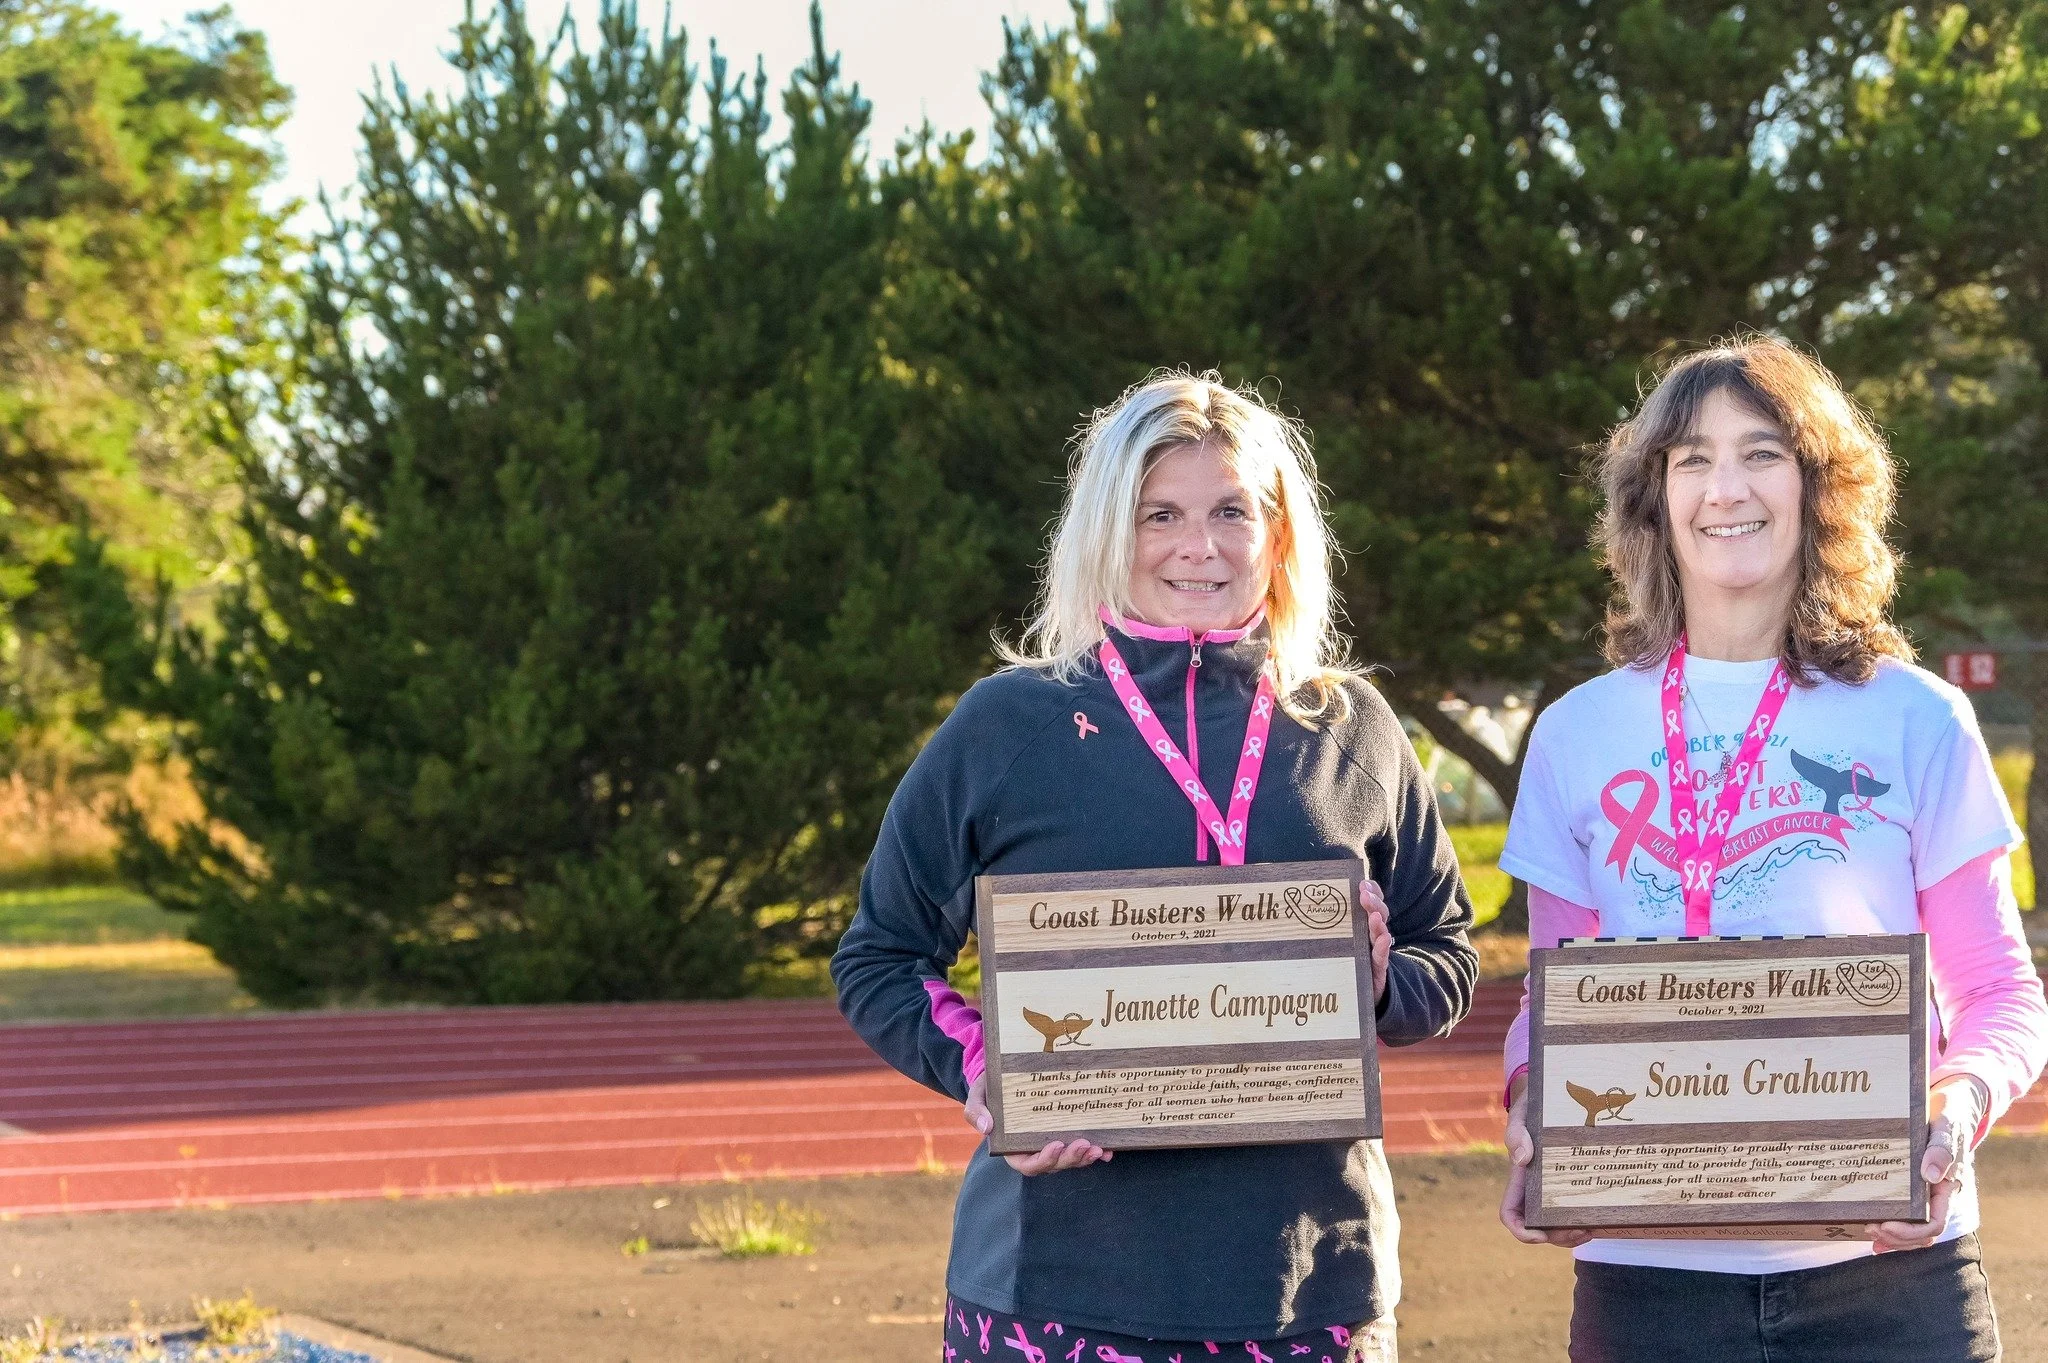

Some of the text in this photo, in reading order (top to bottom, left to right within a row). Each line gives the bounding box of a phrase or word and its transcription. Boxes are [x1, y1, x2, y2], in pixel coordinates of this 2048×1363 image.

[1651, 734, 1726, 767] OCBER
[1651, 814, 1832, 865] WAL BREAST CANCER
[1311, 887, 1326, 897] 1st
[1029, 892, 1280, 930] Coast Busters Walk
[1306, 903, 1337, 915] Annual
[1131, 928, 1217, 941] October 9, 2021
[1865, 964, 1881, 974] 1st
[1576, 968, 1832, 1003] Coast Busters Walk
[1859, 980, 1891, 991] Annual
[1100, 983, 1339, 1029] Jeanette Campagna
[1678, 1004, 1765, 1016] October 9, 2021
[1030, 1062, 1343, 1083] Thanks for this opportunity to proudly raise awareness
[1645, 1057, 1872, 1099] Sonia Graham
[1015, 1075, 1359, 1098] in our community and to provide faith, courage, confidence,
[1032, 1089, 1344, 1113] and hopefulness for all women who have been affected
[1141, 1111, 1236, 1125] by breast cancer
[1570, 1141, 1890, 1158] Thanks for this opportunity to proudly raise awareness
[1555, 1162, 1566, 1172] in
[1569, 1163, 1590, 1172] our
[1593, 1160, 1660, 1172] community
[1662, 1159, 1685, 1170] and
[1688, 1160, 1700, 1169] to
[1703, 1157, 1748, 1171] provide
[1749, 1157, 1783, 1171] faith,
[1785, 1158, 1836, 1169] courage,
[1570, 1170, 1889, 1188] and hopefulness for all women who have been affected
[1680, 1189, 1777, 1202] by breast cancer
[1643, 1227, 1707, 1236] Counter
